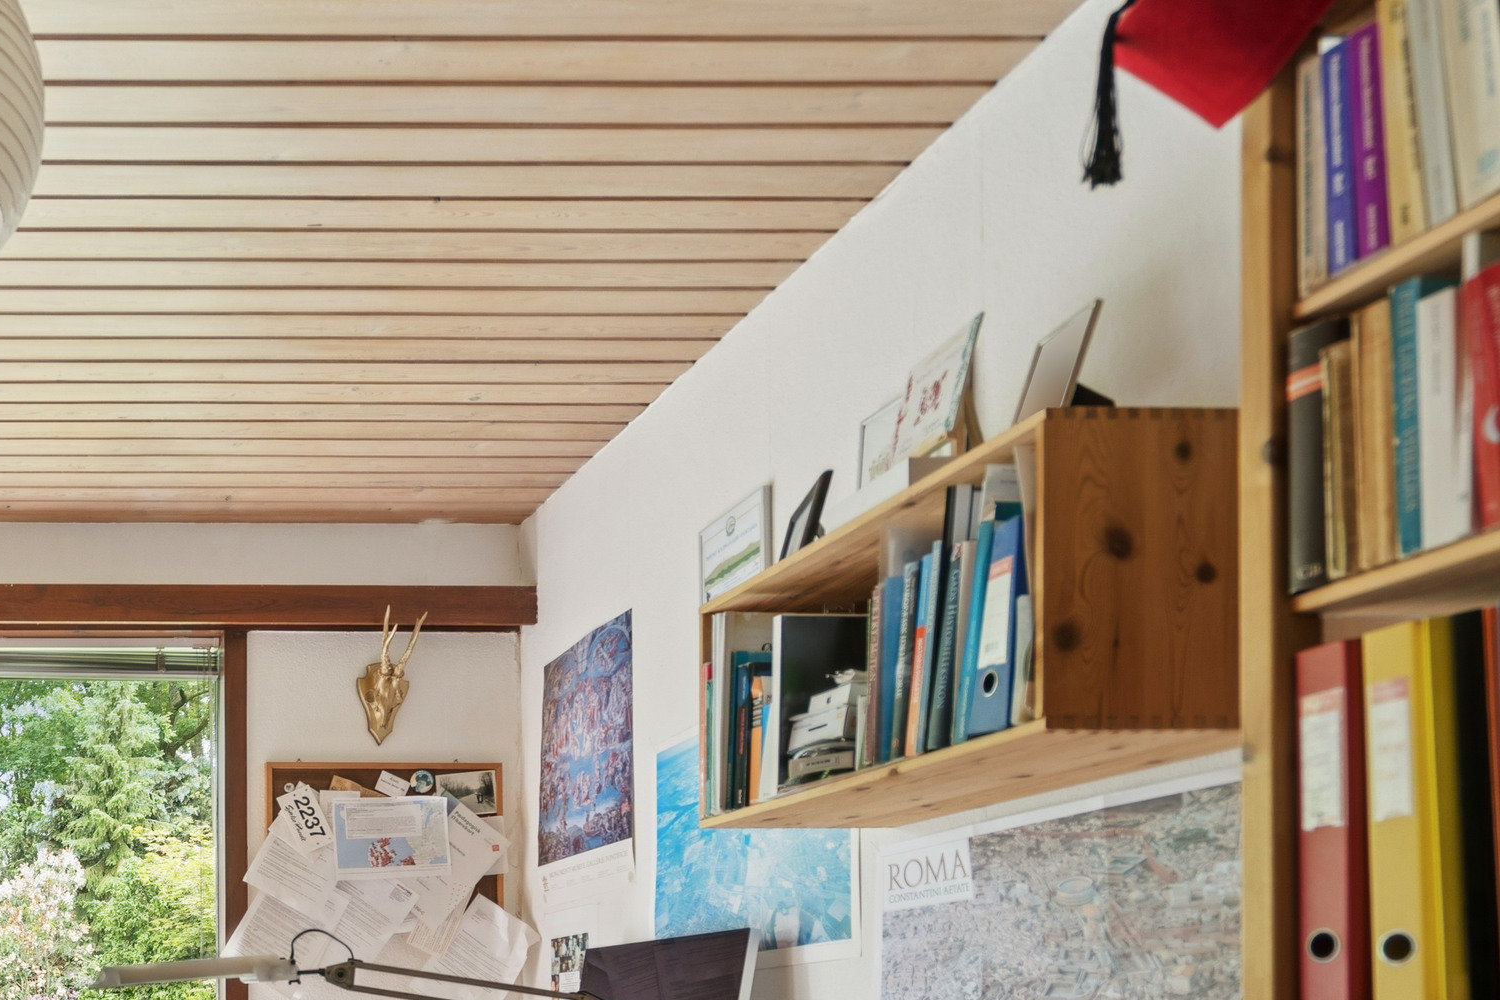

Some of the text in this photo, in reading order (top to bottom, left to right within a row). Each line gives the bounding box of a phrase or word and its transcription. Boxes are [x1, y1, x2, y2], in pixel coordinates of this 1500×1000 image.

[293, 796, 327, 838] 2237
[888, 849, 970, 892] ROMA
[889, 888, 943, 904] CONSTANTINI
